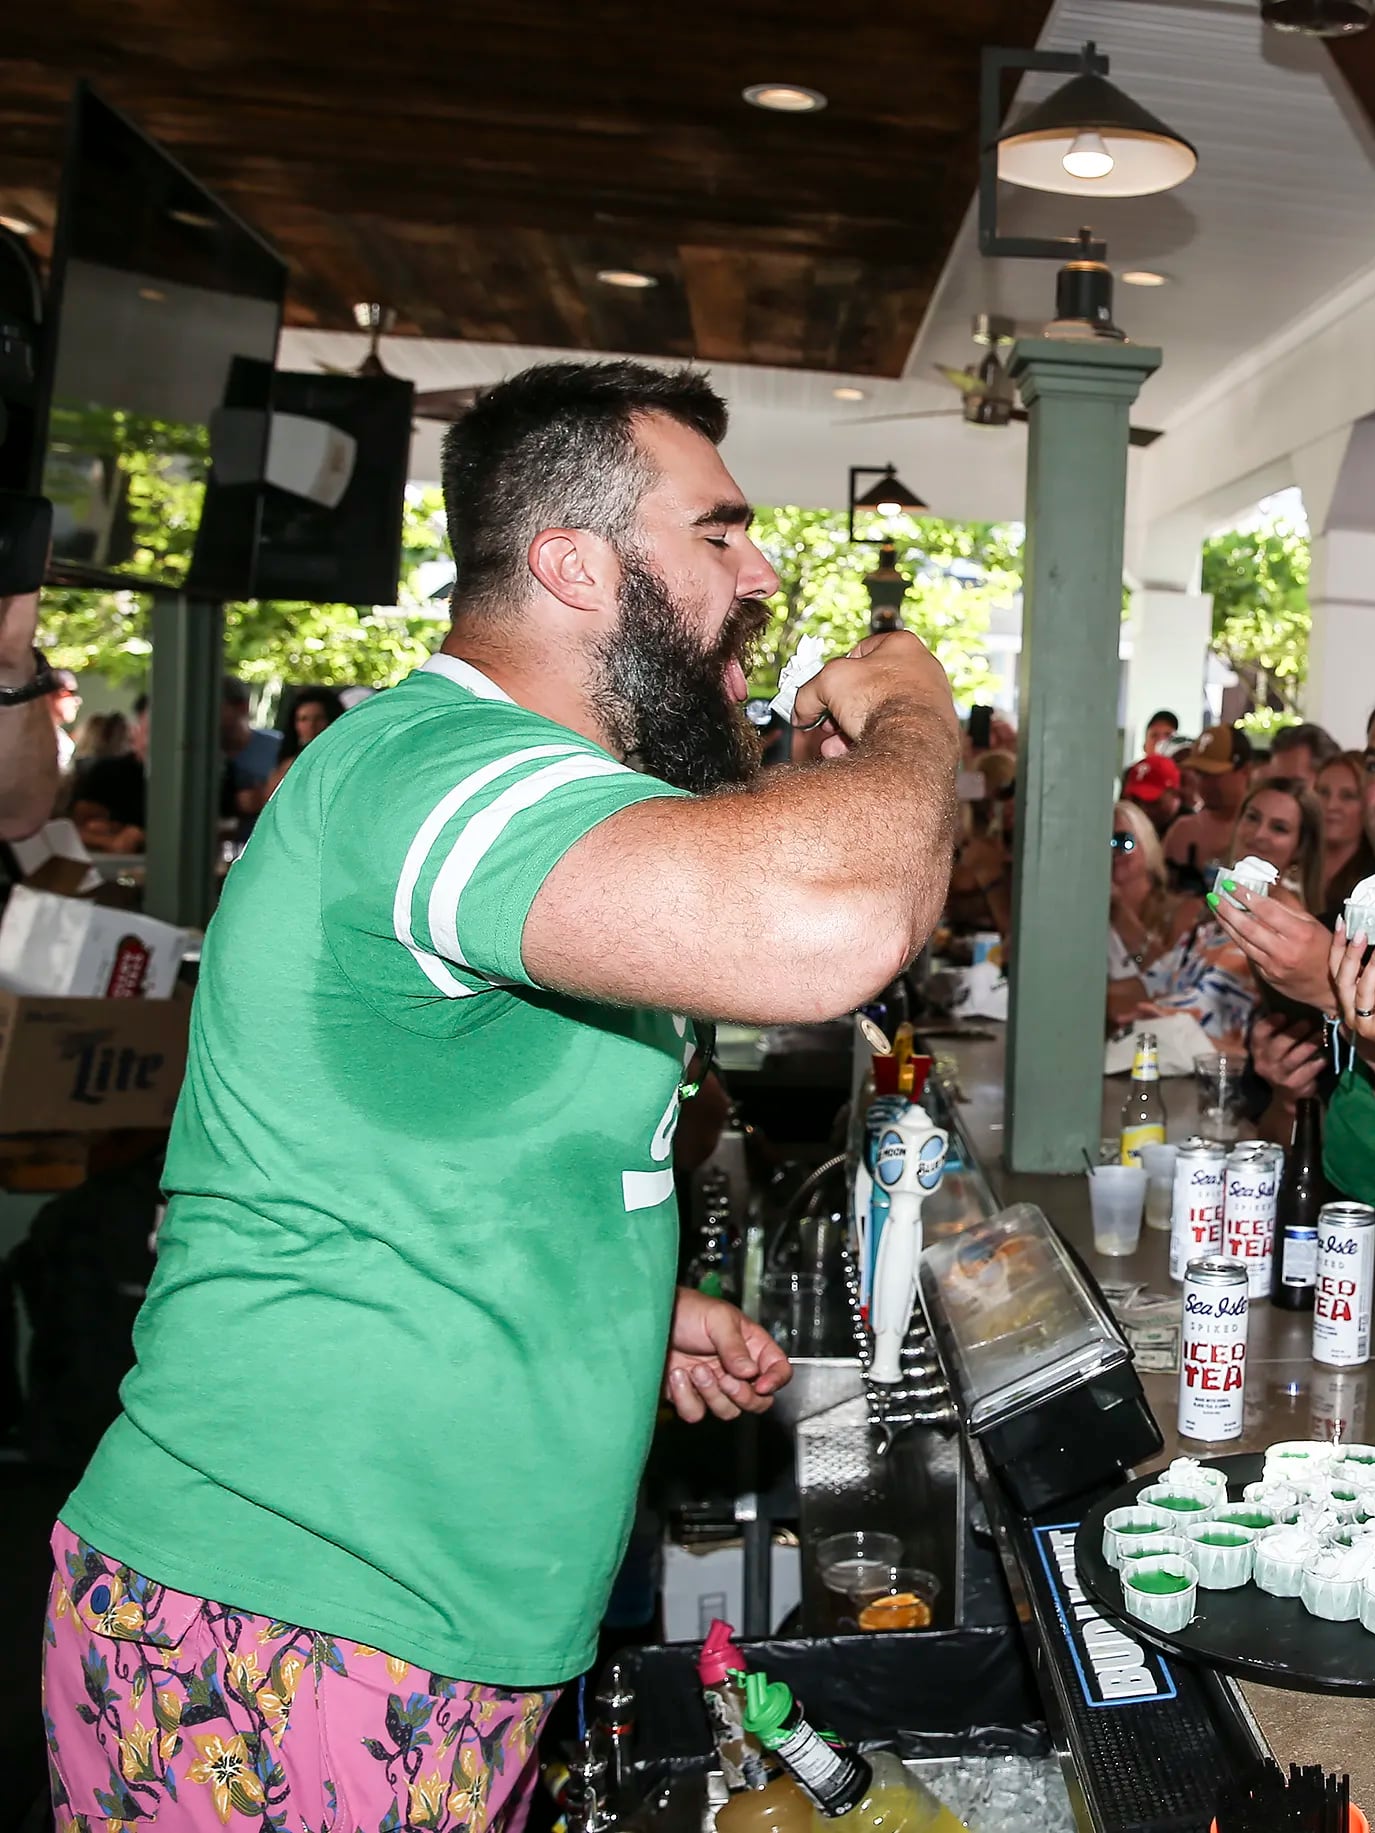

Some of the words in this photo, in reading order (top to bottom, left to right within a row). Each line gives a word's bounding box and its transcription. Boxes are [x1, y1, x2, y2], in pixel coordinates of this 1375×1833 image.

[57, 1027, 164, 1104] Lite
[1190, 1205, 1224, 1223] ICE
[1191, 1225, 1221, 1243] TE
[1325, 1235, 1359, 1255] Isle
[1317, 1273, 1357, 1297] ED
[1185, 1293, 1214, 1316] Sea
[1214, 1295, 1248, 1319] Isle
[1316, 1296, 1352, 1322] EA
[1184, 1340, 1246, 1364] ICED
[1184, 1362, 1242, 1392] TEA
[1082, 1618, 1158, 1700] BUD
